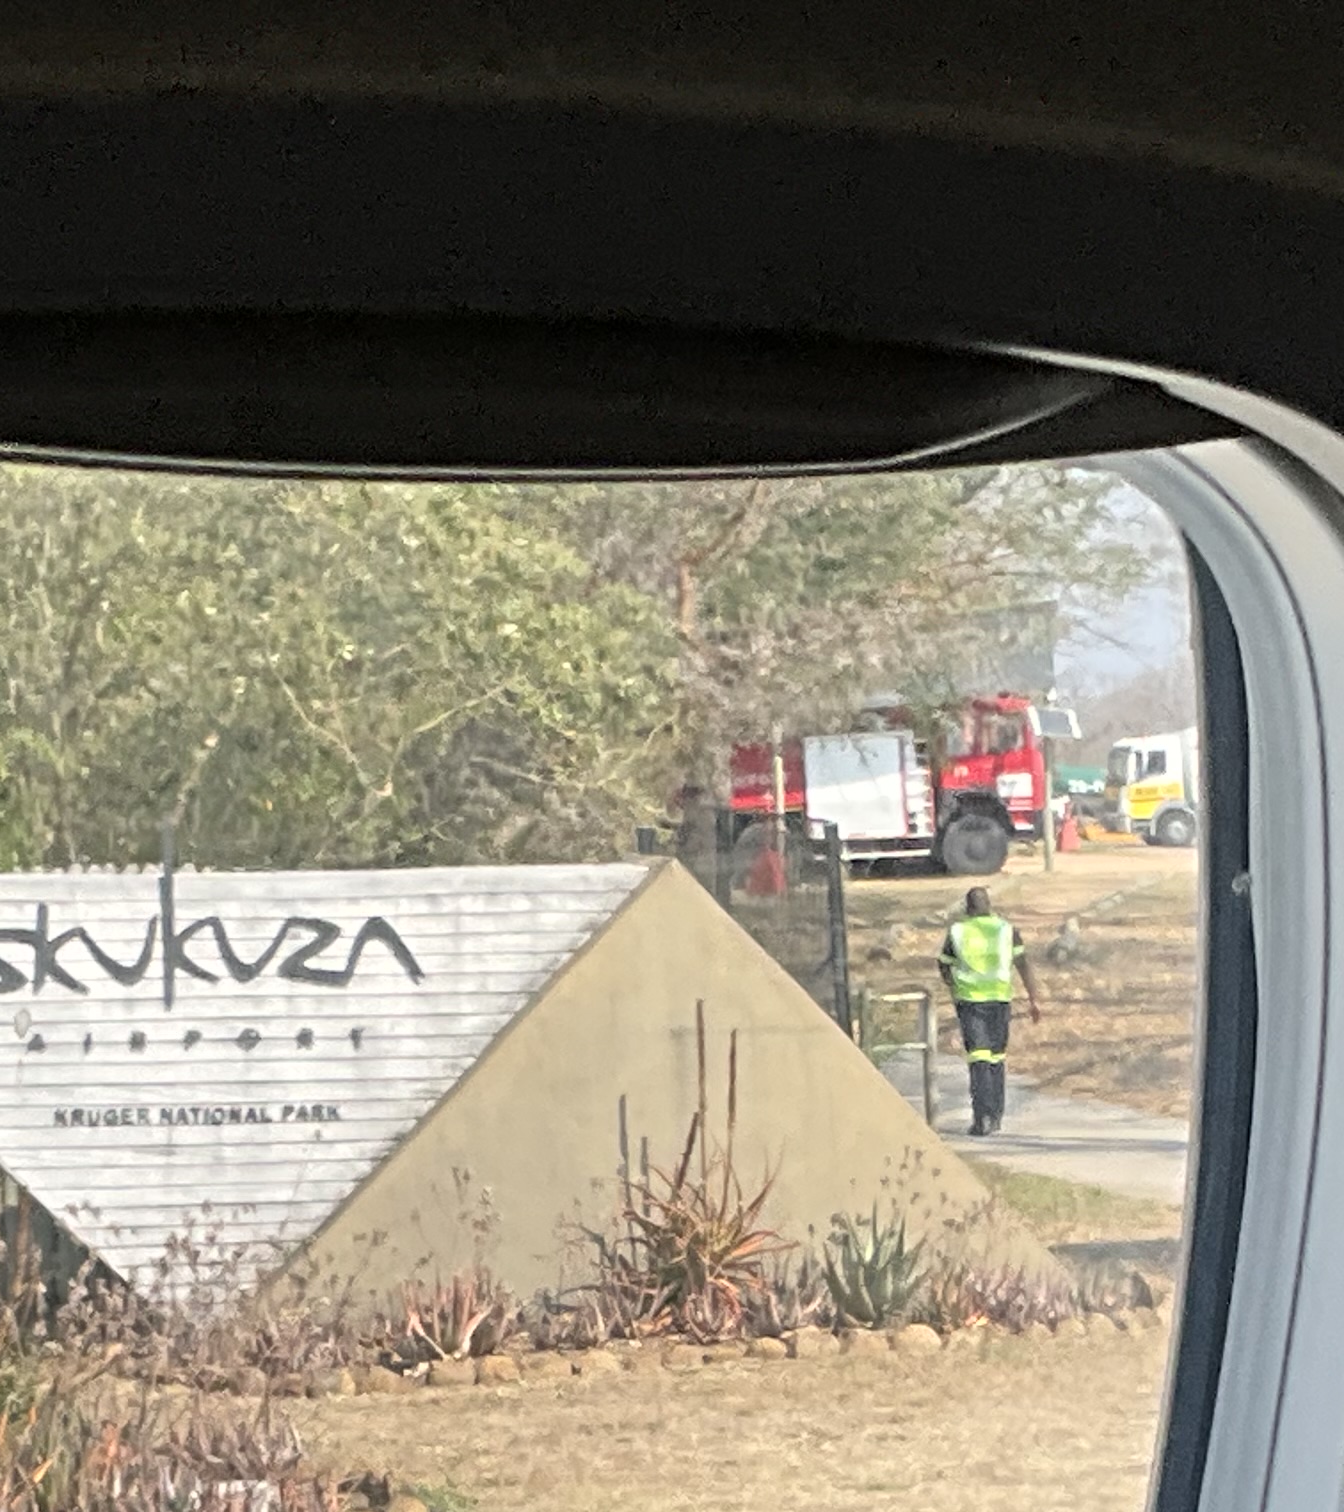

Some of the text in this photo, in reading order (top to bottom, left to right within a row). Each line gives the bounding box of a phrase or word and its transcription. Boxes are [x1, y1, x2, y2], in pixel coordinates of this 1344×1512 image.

[25, 1027, 364, 1055] AIRPORT
[53, 1103, 342, 1127] KRUGER NATIONAL PARK
